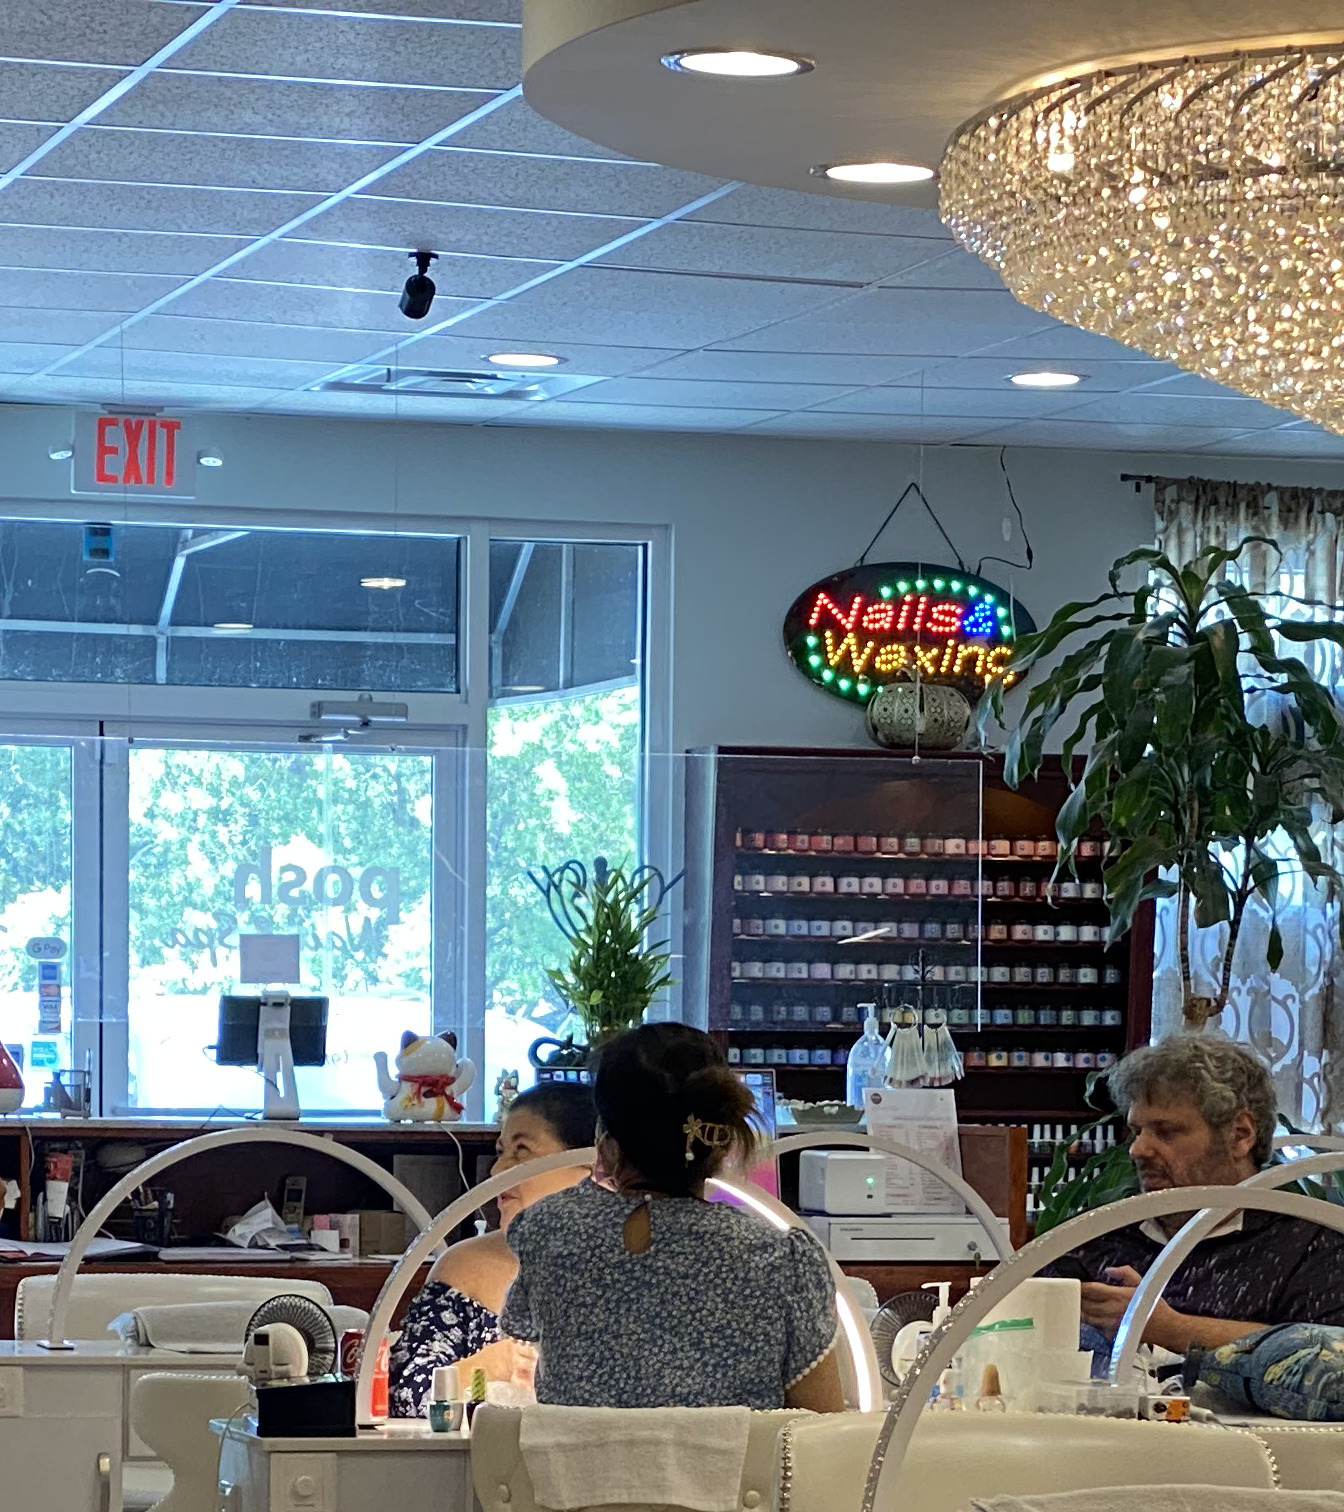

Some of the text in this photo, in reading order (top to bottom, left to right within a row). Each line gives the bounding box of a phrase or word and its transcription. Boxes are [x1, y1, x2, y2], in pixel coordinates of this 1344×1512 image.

[95, 416, 182, 488] EXIT
[808, 592, 993, 635] Nails &
[44, 943, 62, 956] Pay
